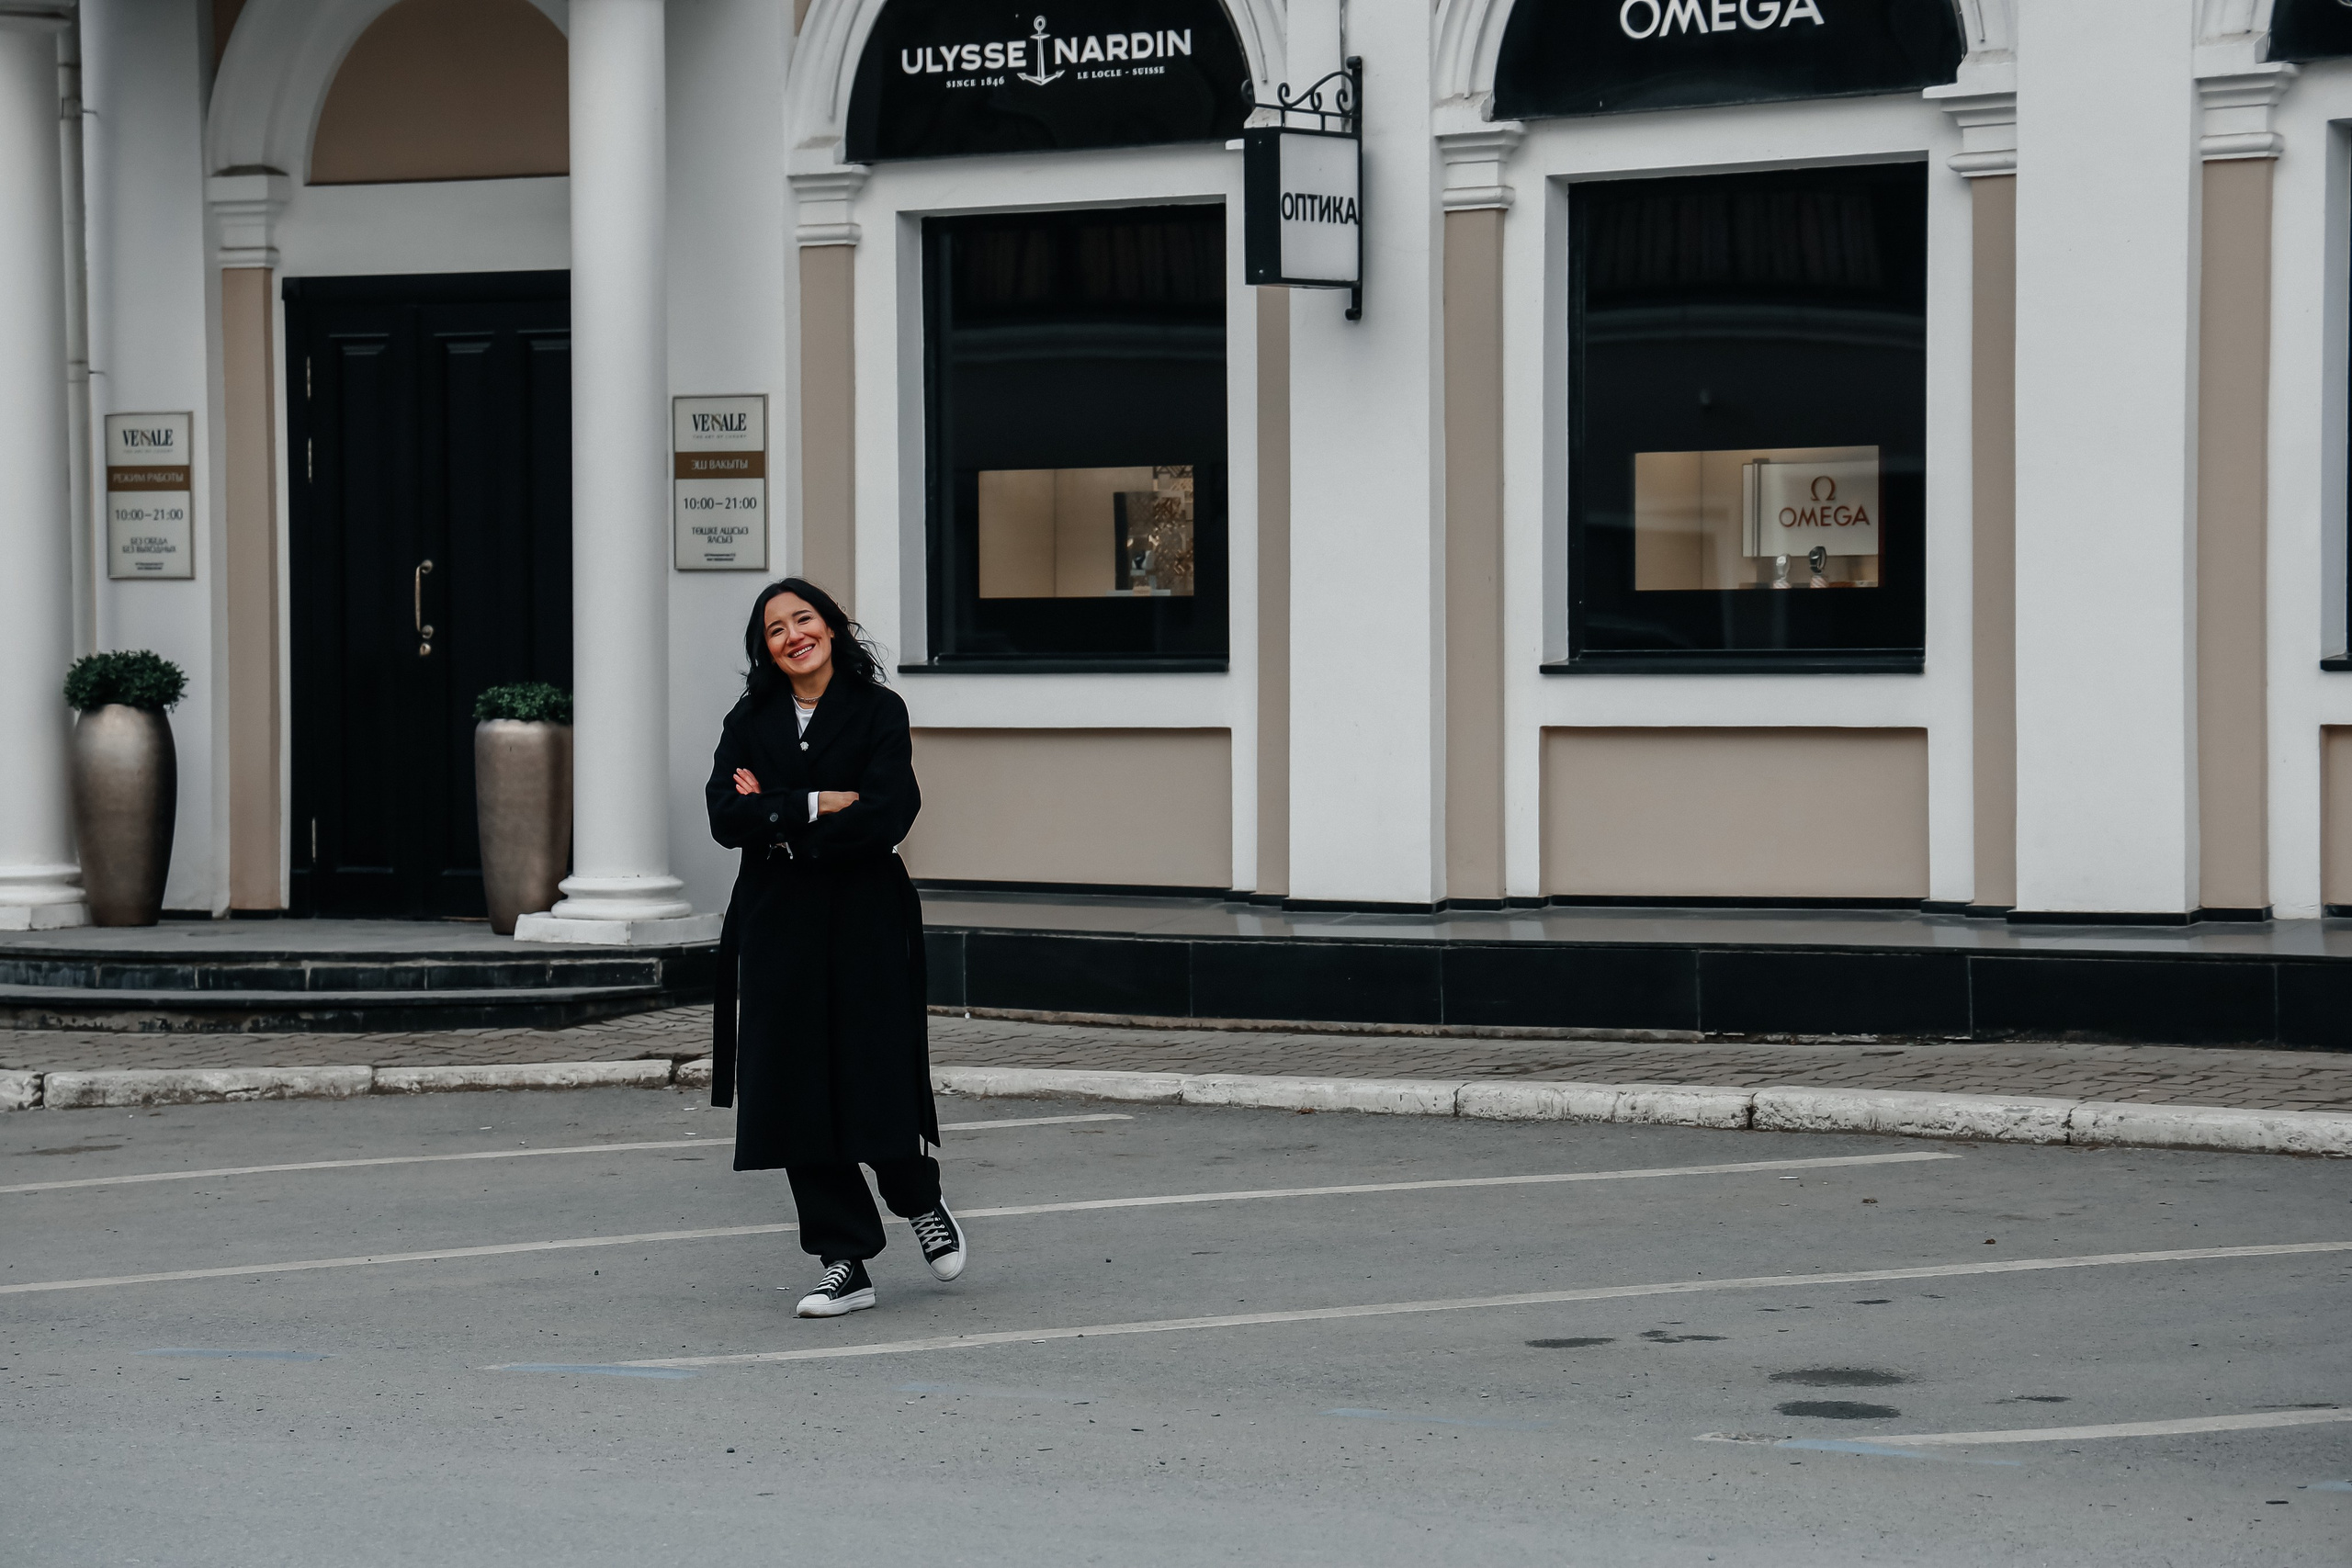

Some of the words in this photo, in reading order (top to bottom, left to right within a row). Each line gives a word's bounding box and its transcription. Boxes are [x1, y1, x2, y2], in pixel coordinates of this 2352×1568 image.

[1620, 0, 1825, 39] OMEGA
[901, 40, 1027, 74] ULYSSE
[1054, 28, 1192, 65] NARDIN
[945, 79, 977, 88] SINCE
[980, 76, 1005, 87] 1846
[1077, 72, 1089, 80] LE
[1091, 69, 1123, 79] LOCLE
[1132, 66, 1166, 76] SUISSE
[1282, 192, 1359, 225] ОПТИКА
[691, 459, 707, 470] ЭШ
[708, 459, 749, 469] ВАКЫТЫ
[146, 472, 184, 483] РАБОТЫ
[1779, 505, 1871, 528] OMEGA
